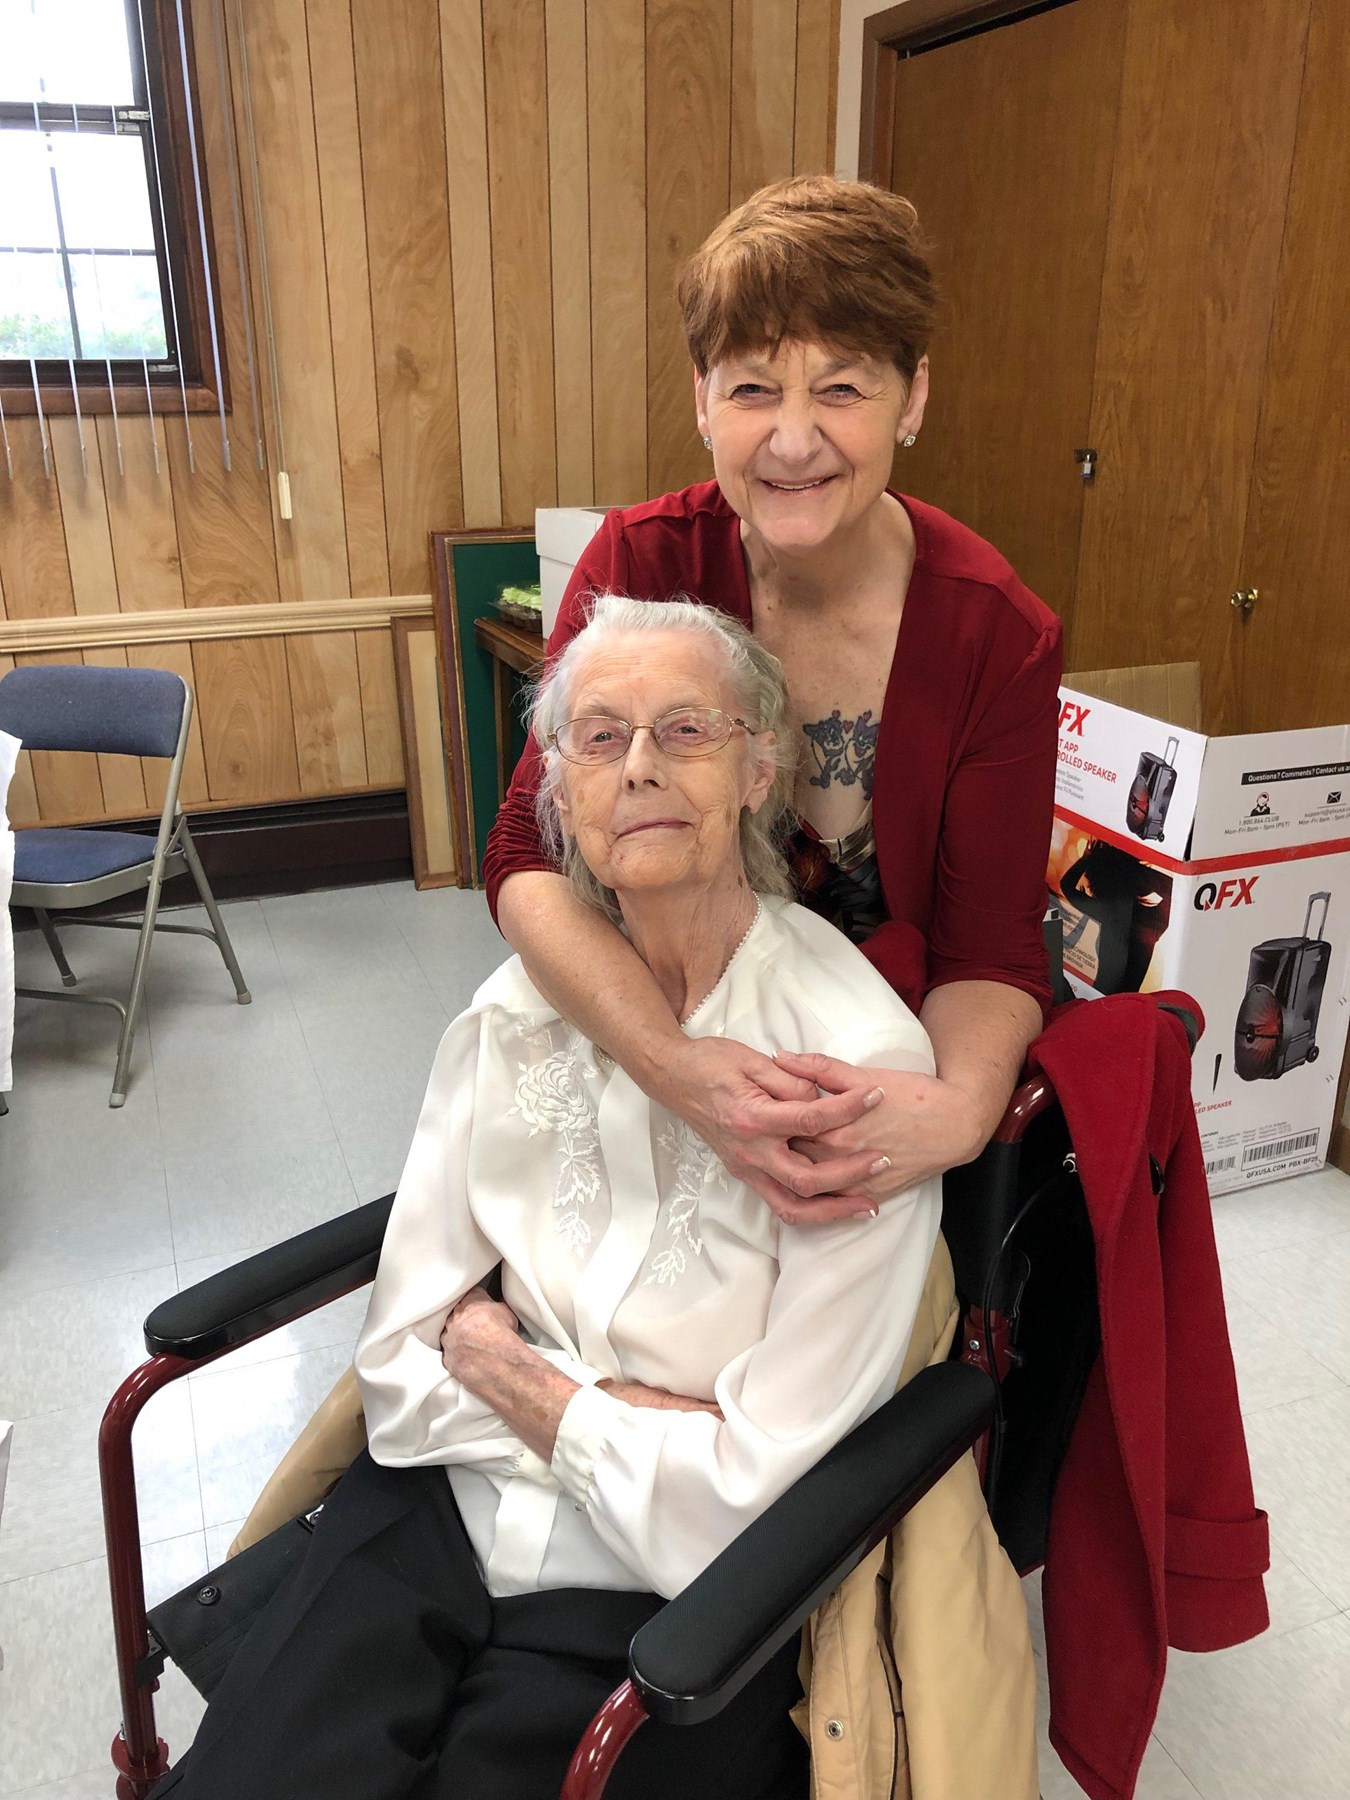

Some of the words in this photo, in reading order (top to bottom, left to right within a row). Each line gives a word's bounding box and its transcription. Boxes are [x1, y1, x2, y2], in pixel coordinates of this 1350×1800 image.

[1057, 698, 1091, 737] FX
[1063, 740, 1079, 753] APP
[1083, 761, 1117, 783] SPEAKER
[1247, 772, 1280, 782] Questions?
[1281, 768, 1315, 779] Comments?
[1315, 766, 1337, 775] Contact
[1193, 875, 1260, 912] QFX
[1206, 1100, 1232, 1112] SPEAKER
